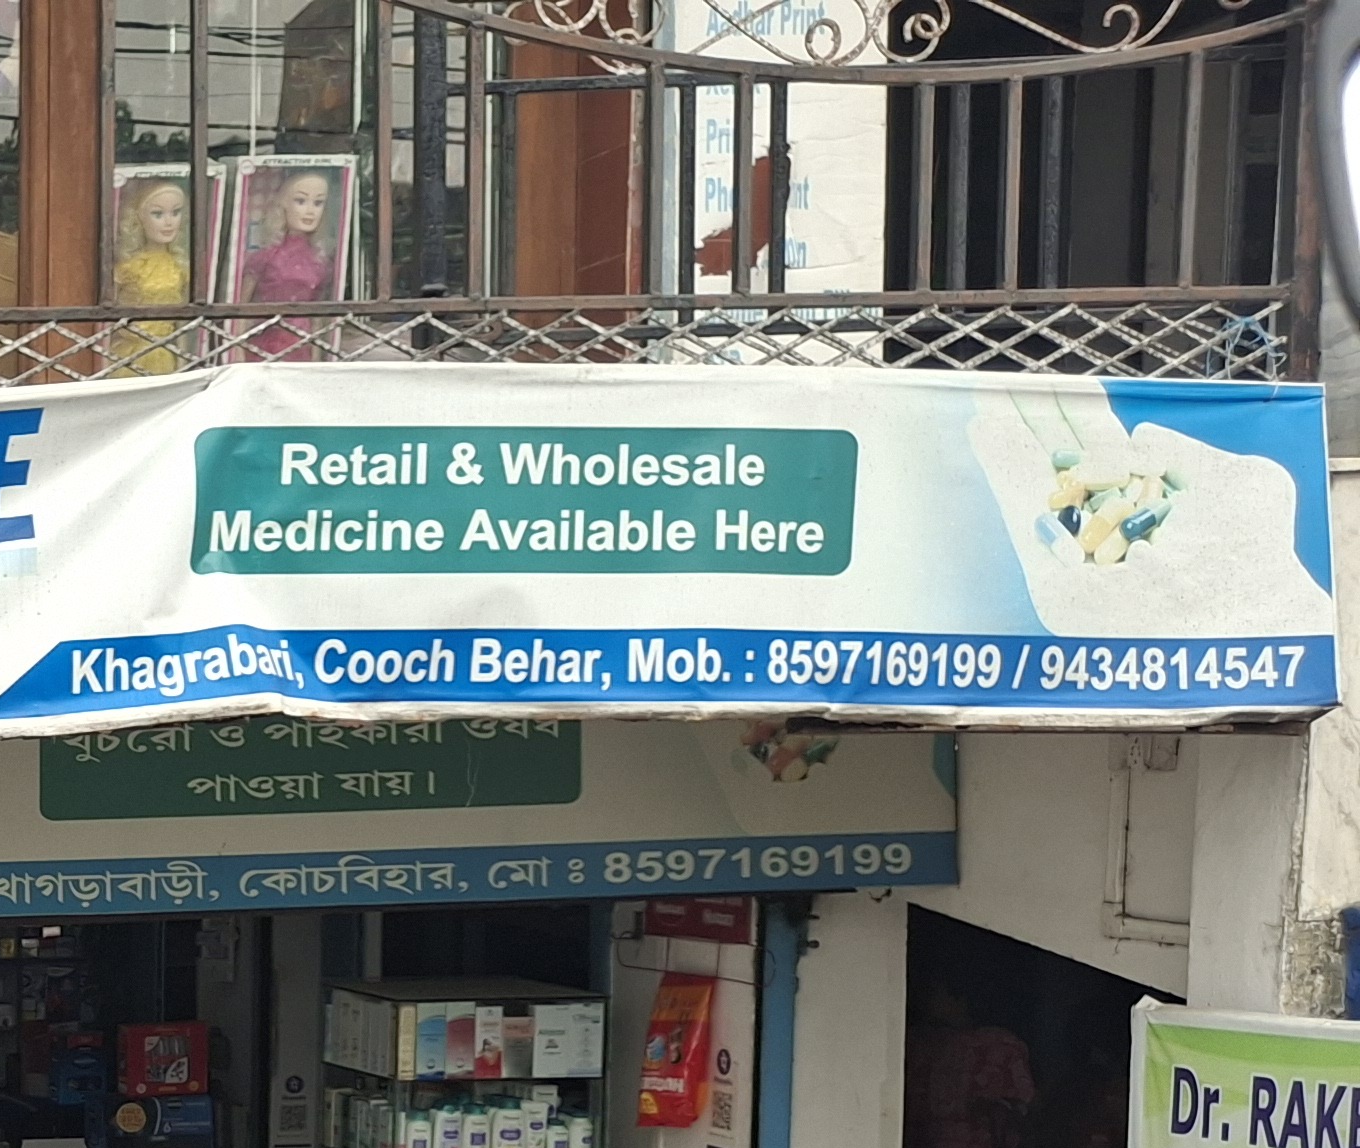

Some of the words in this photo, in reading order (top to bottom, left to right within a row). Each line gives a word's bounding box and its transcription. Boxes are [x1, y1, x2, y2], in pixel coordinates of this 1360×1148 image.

[281, 442, 427, 486] Retail
[446, 442, 484, 486] &
[500, 442, 766, 487] Wholesale
[209, 508, 445, 553] Medicine
[460, 508, 696, 553] Available
[714, 509, 825, 554] Here
[70, 633, 305, 698] Khagrabari,
[314, 638, 455, 685] Cooch
[469, 638, 612, 691] Behar,
[627, 637, 732, 684] Mob.
[766, 637, 1002, 688] 8597169199
[1040, 644, 1306, 691] 9434814547
[186, 770, 325, 803] পাওয়া
[602, 844, 914, 885] 8597169199
[1170, 1065, 1230, 1142] Dr.
